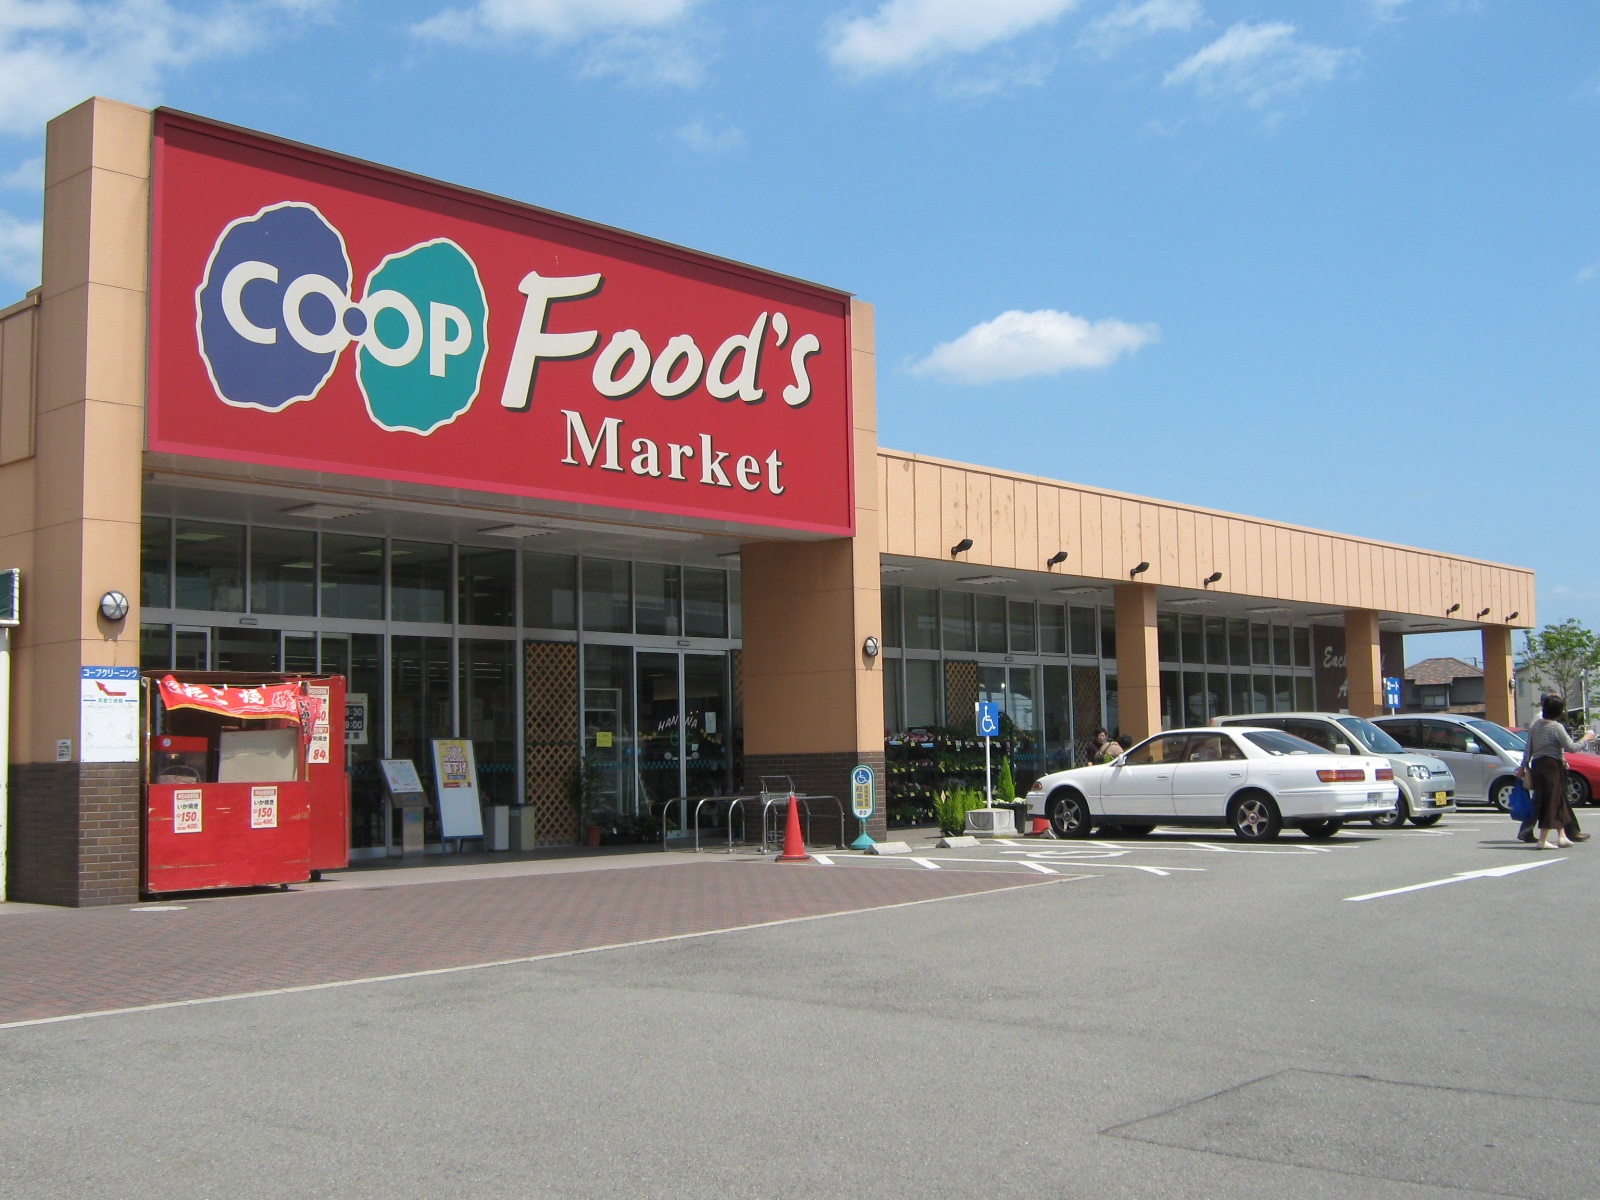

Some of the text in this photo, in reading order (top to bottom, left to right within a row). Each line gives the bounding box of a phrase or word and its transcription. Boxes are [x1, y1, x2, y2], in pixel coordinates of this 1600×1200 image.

[500, 271, 820, 410] Food's
[560, 409, 786, 496] Market
[83, 668, 138, 678] コープクリーニング
